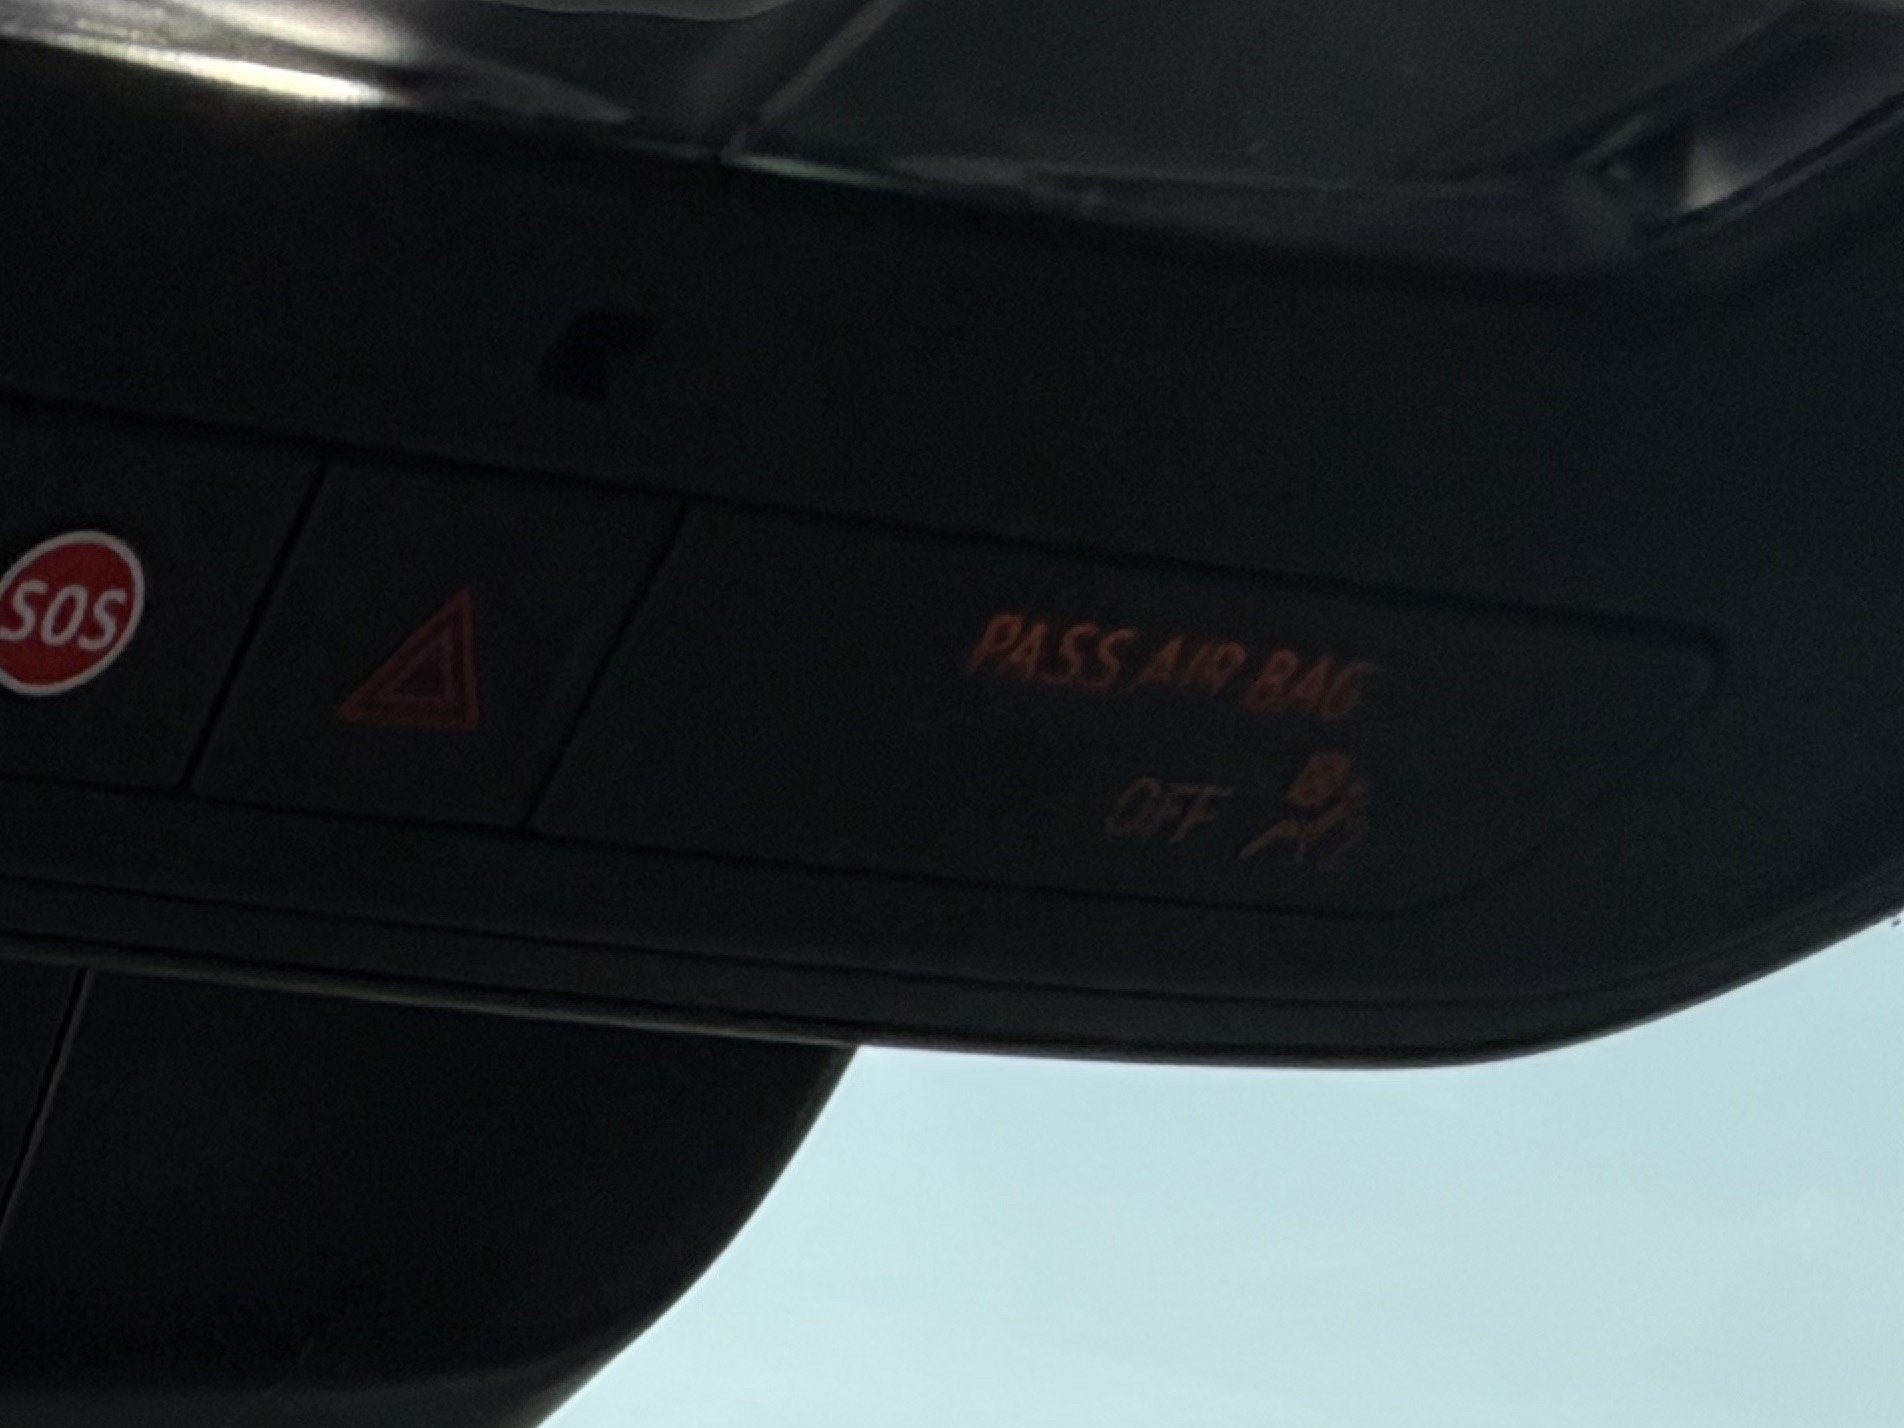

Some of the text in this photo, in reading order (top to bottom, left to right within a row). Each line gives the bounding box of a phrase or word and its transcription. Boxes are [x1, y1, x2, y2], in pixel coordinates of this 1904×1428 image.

[965, 610, 1376, 723] PASS AIR BAG
[1103, 776, 1235, 845] OFF
